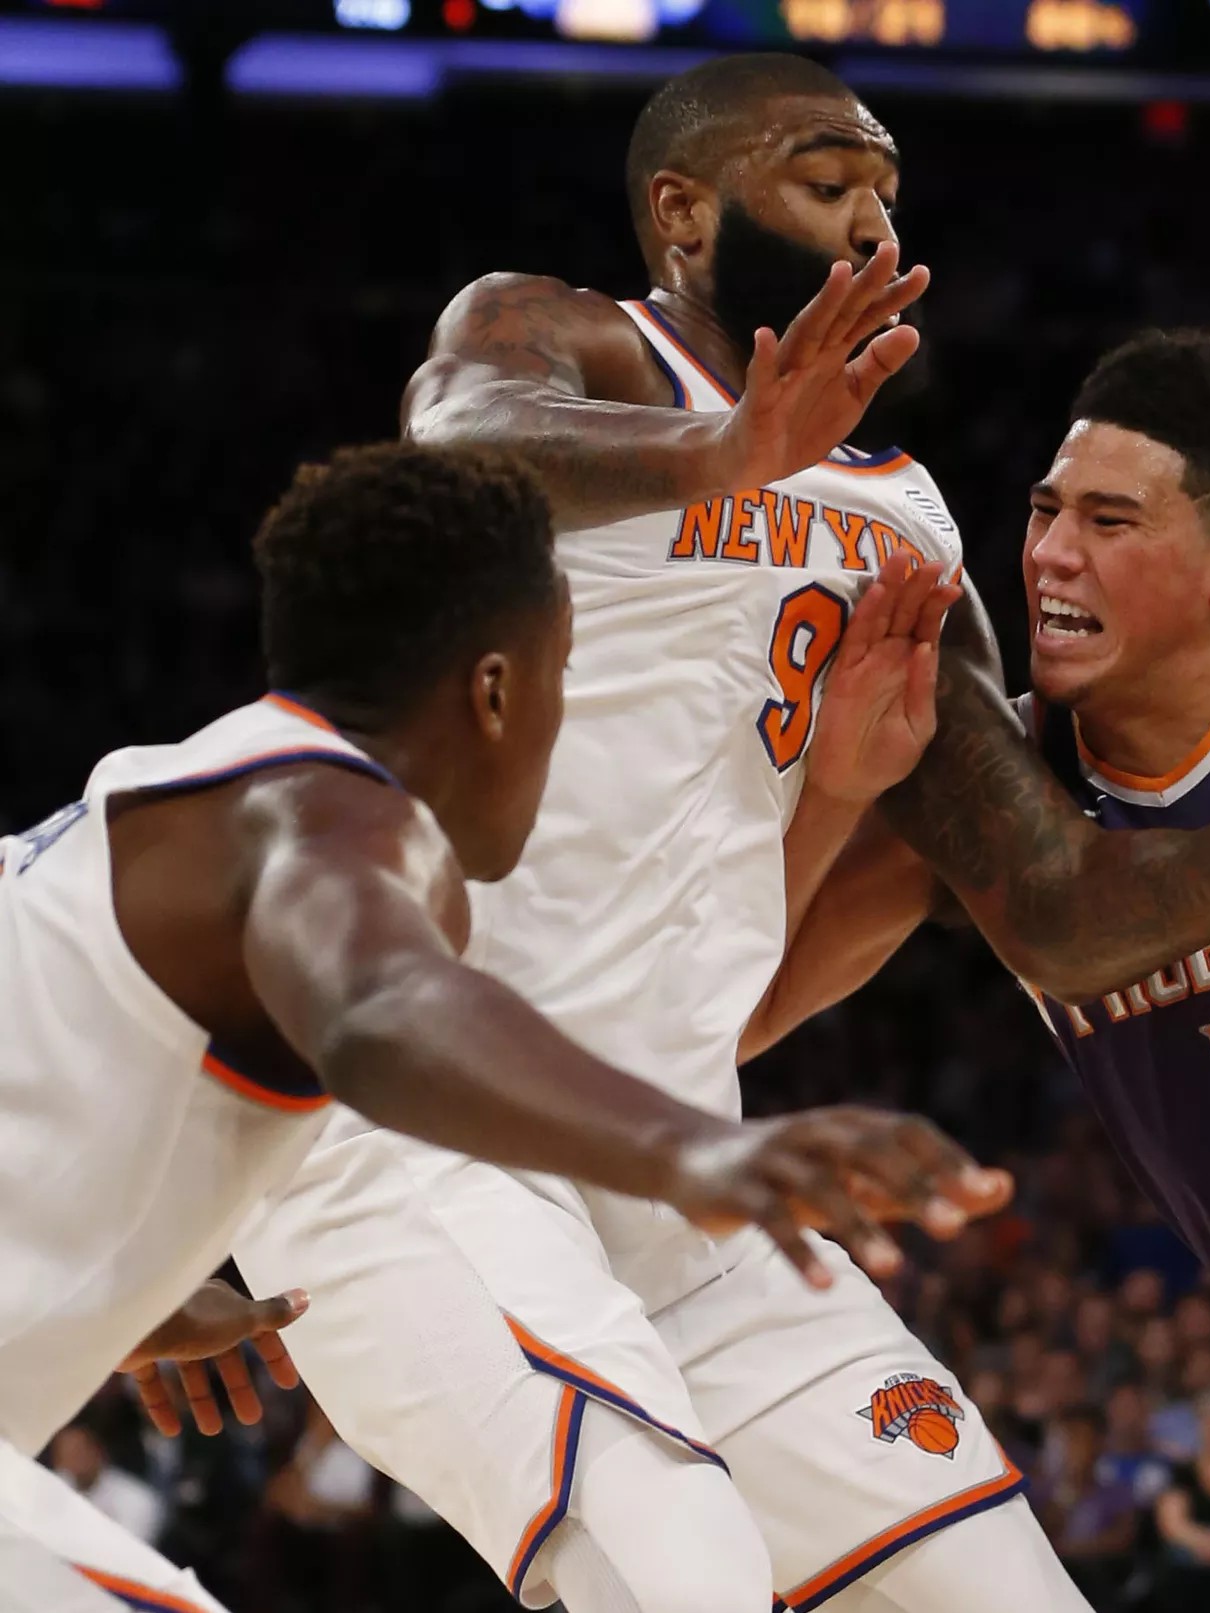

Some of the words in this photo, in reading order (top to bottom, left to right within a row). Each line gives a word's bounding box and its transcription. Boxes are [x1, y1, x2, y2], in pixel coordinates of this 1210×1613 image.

[667, 487, 814, 569] NEW
[756, 581, 849, 774] 9
[870, 1377, 963, 1438] KNICKS
